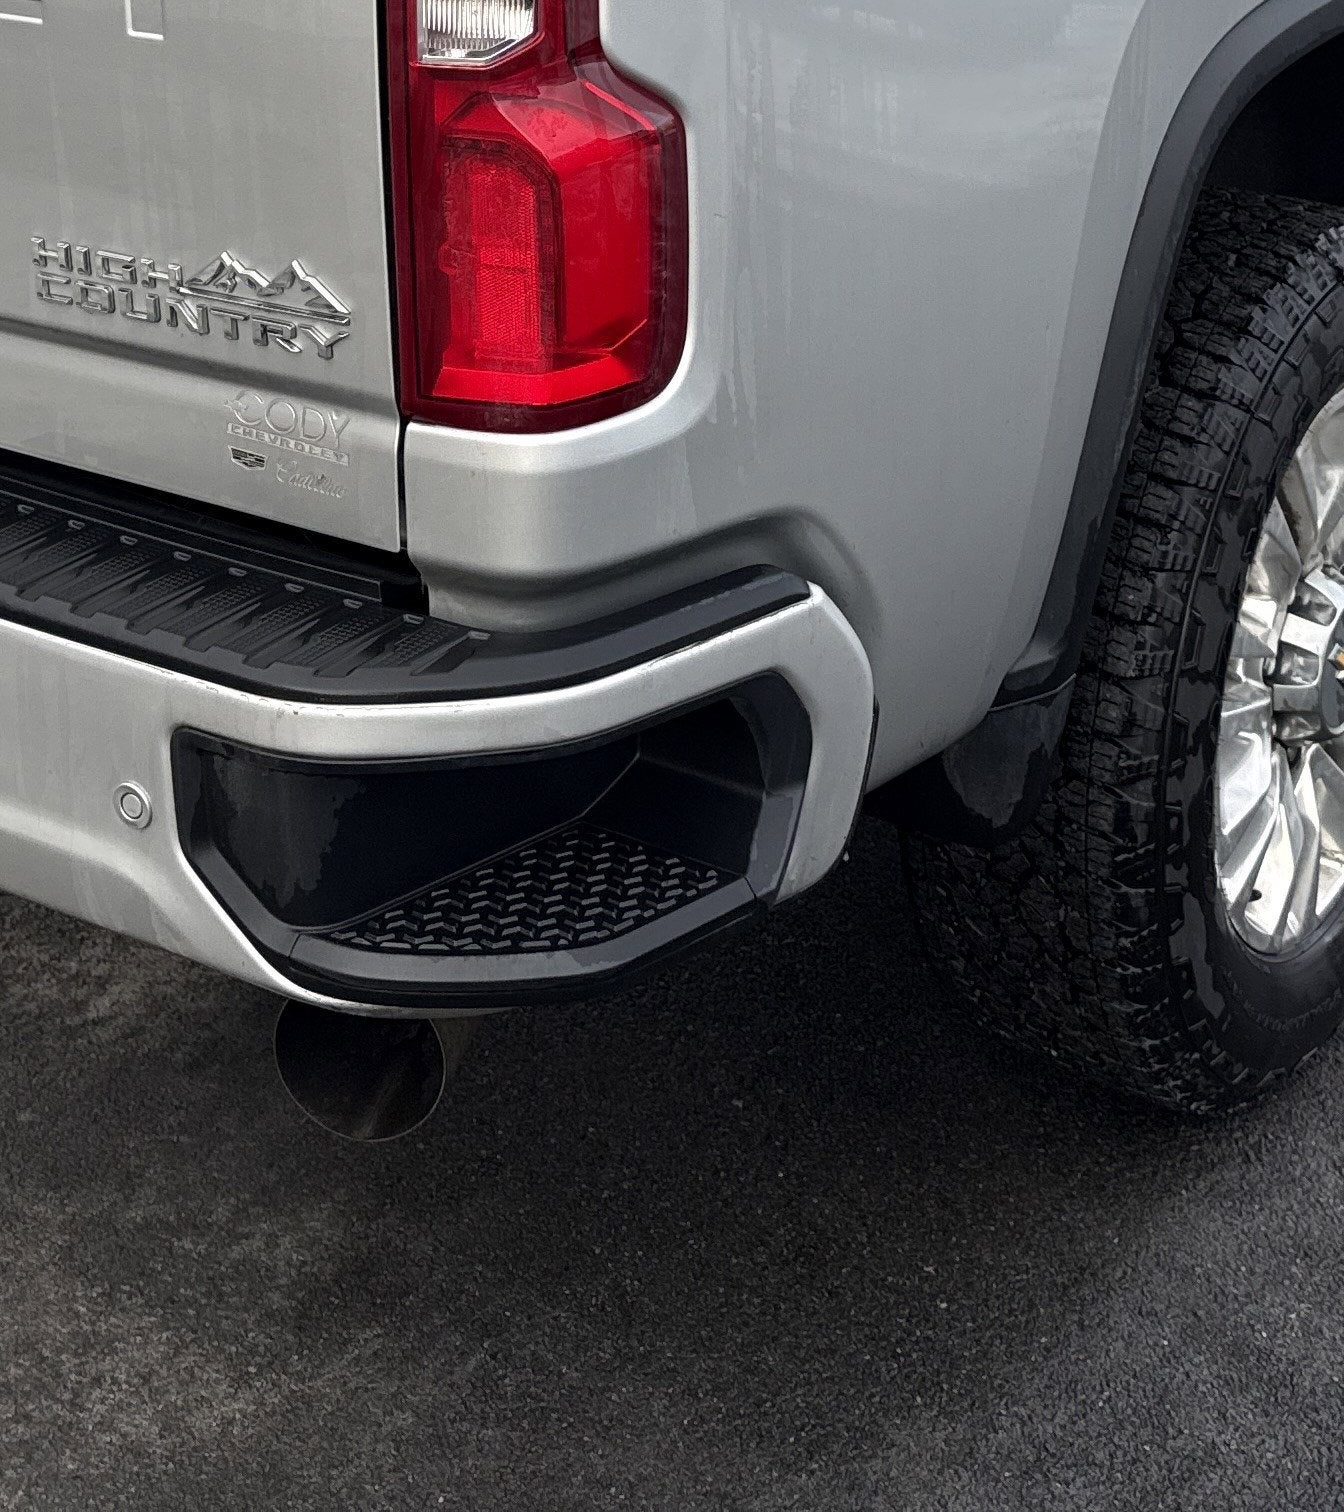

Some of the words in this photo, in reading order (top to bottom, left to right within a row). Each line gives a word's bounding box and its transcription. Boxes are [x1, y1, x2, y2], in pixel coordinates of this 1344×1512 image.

[30, 236, 186, 289] HIGH
[35, 271, 351, 361] COUNTRY
[224, 389, 352, 450] CODY
[228, 423, 349, 466] CHEVROLET
